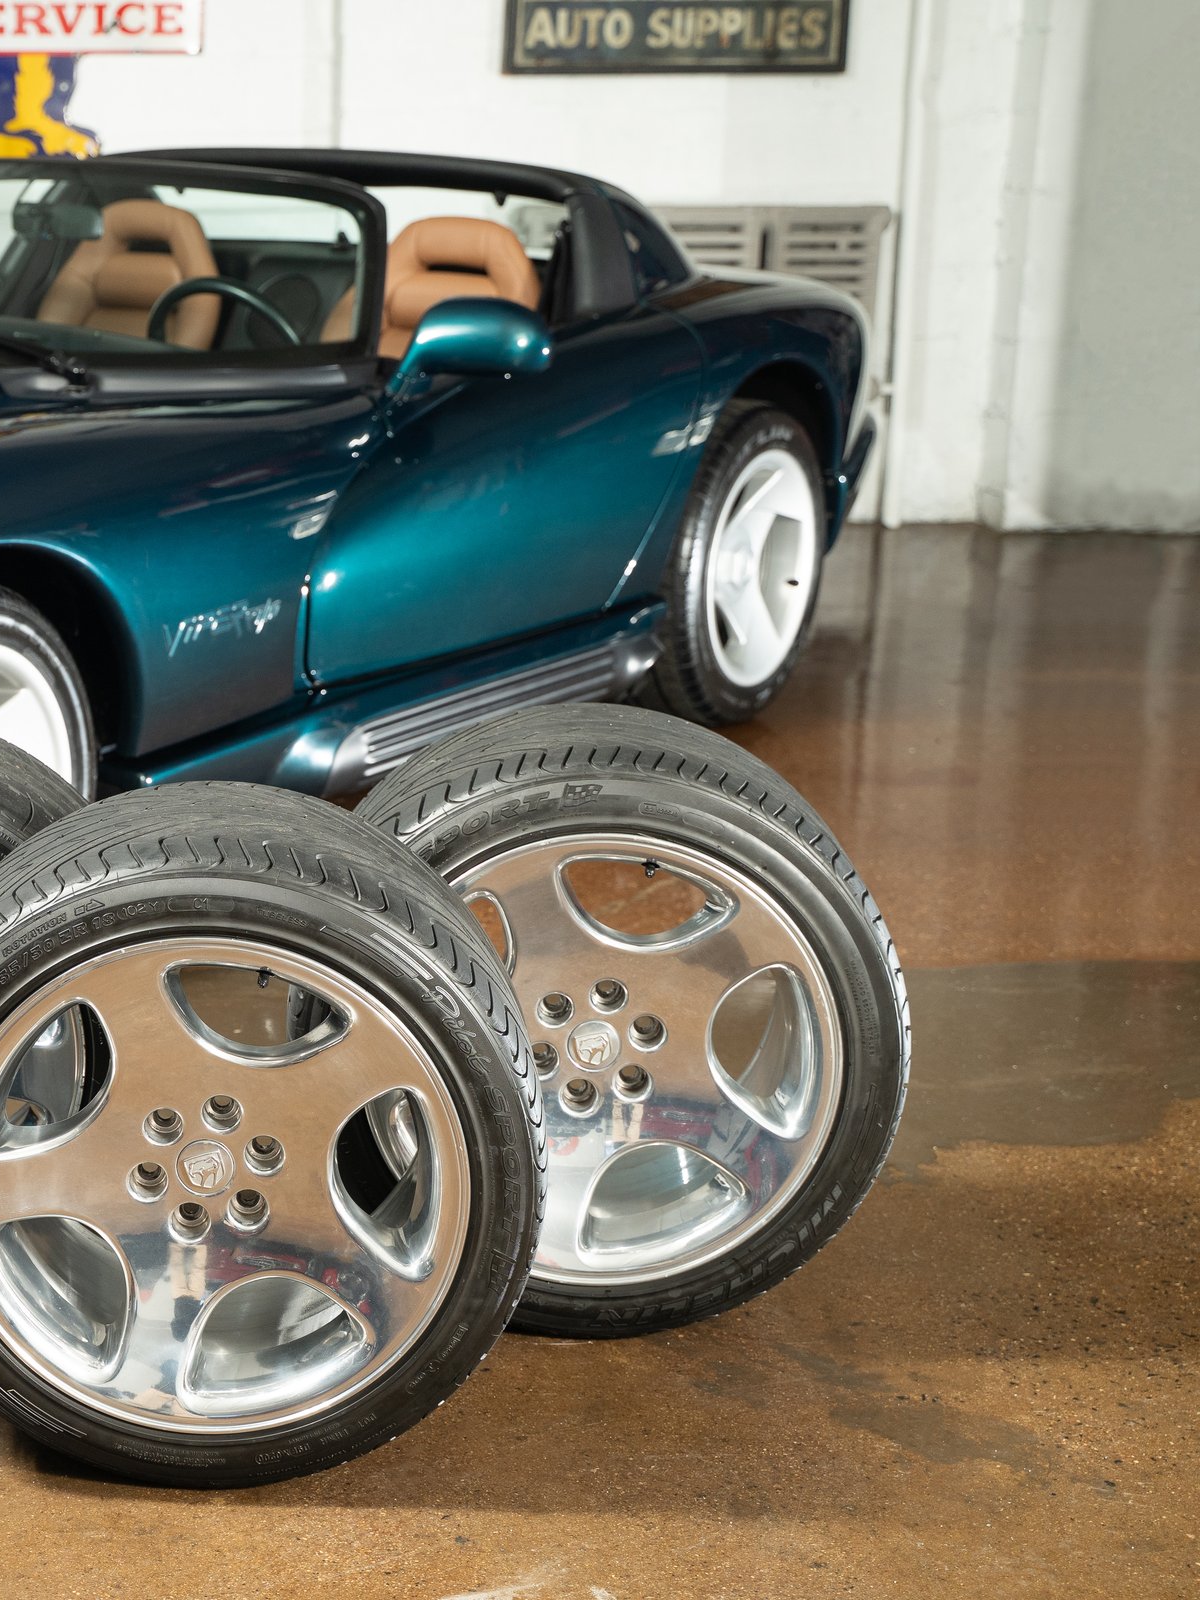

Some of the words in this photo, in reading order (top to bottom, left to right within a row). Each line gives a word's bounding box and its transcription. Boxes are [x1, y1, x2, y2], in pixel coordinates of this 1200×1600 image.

[524, 8, 635, 50] AUTO
[645, 7, 828, 49] SUPPLIES
[192, 897, 210, 910] C1
[2, 913, 68, 956] ROTATION
[57, 921, 89, 945] ZR
[421, 985, 490, 1078] Pilot
[484, 1084, 523, 1247] SPORT
[589, 1181, 846, 1329] MICHELIN
